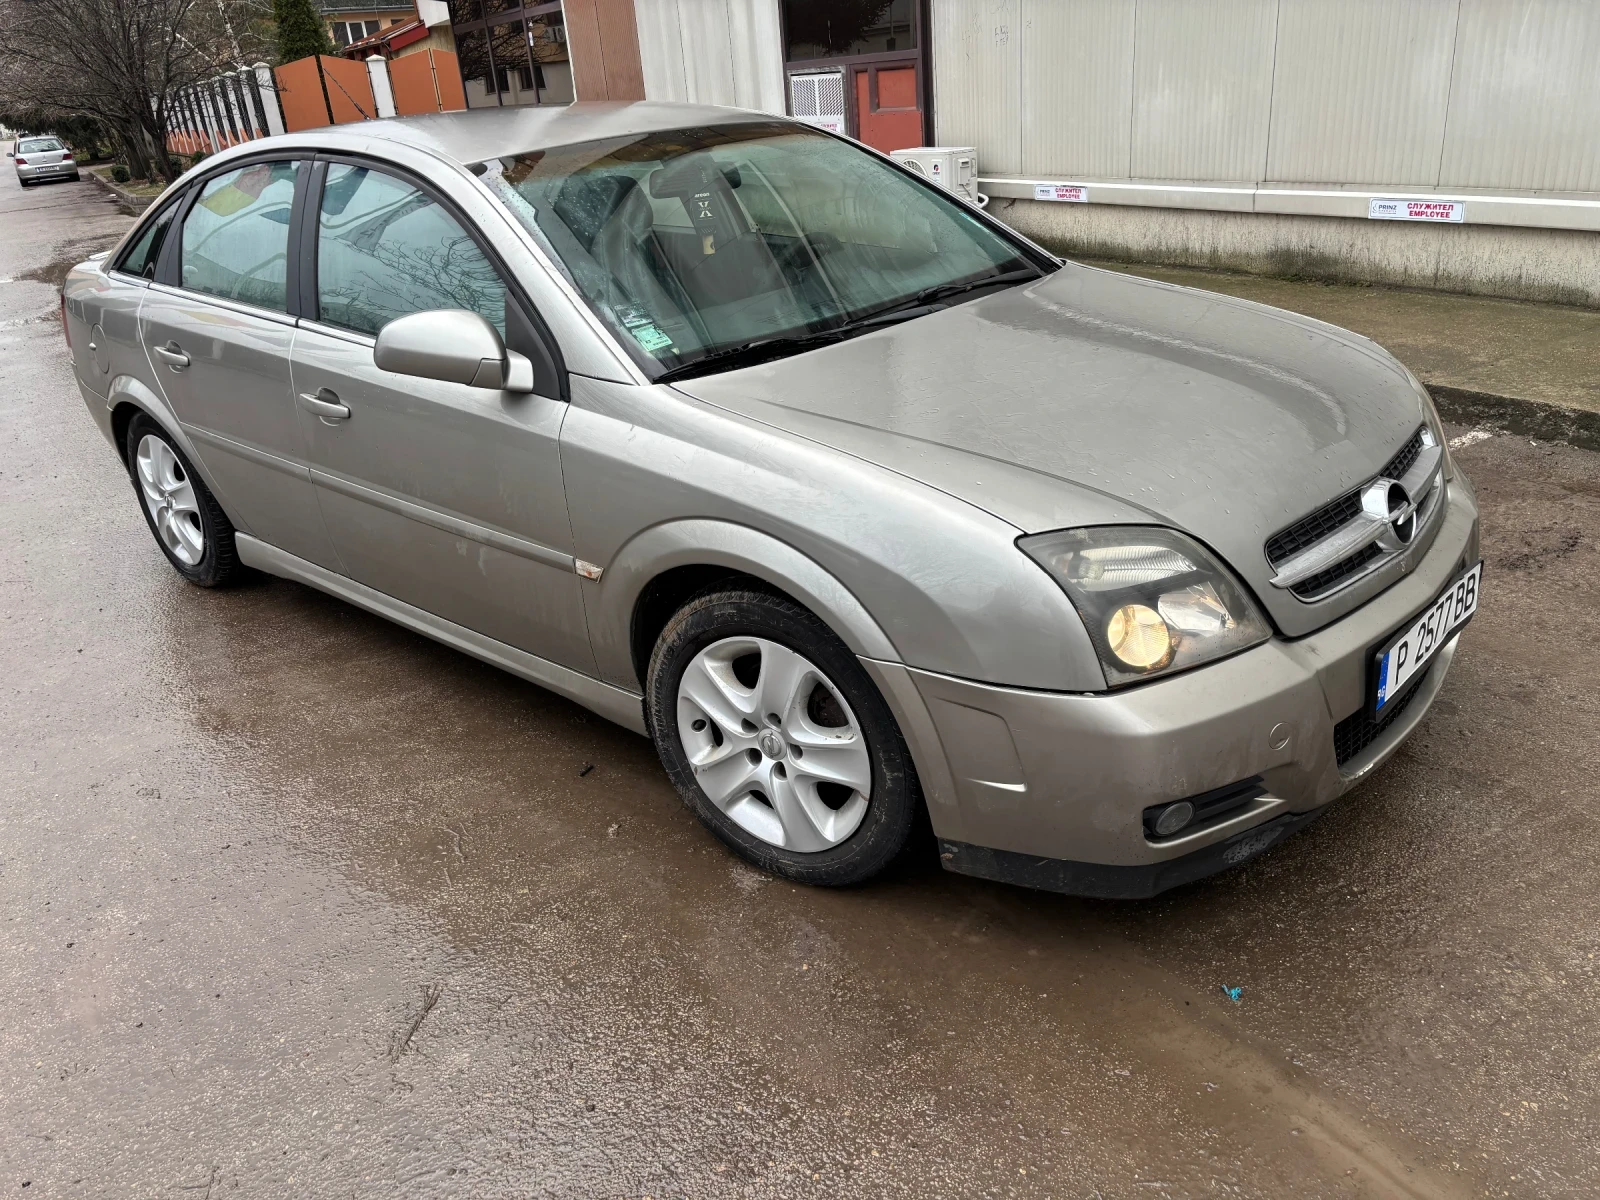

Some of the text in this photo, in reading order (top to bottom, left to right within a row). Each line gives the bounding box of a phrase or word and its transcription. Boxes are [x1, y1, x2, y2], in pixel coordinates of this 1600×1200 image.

[1407, 202, 1454, 211] СЛУЖИТЕЛ
[1409, 210, 1451, 218] EMPLOYEE
[1395, 640, 1409, 686] P
